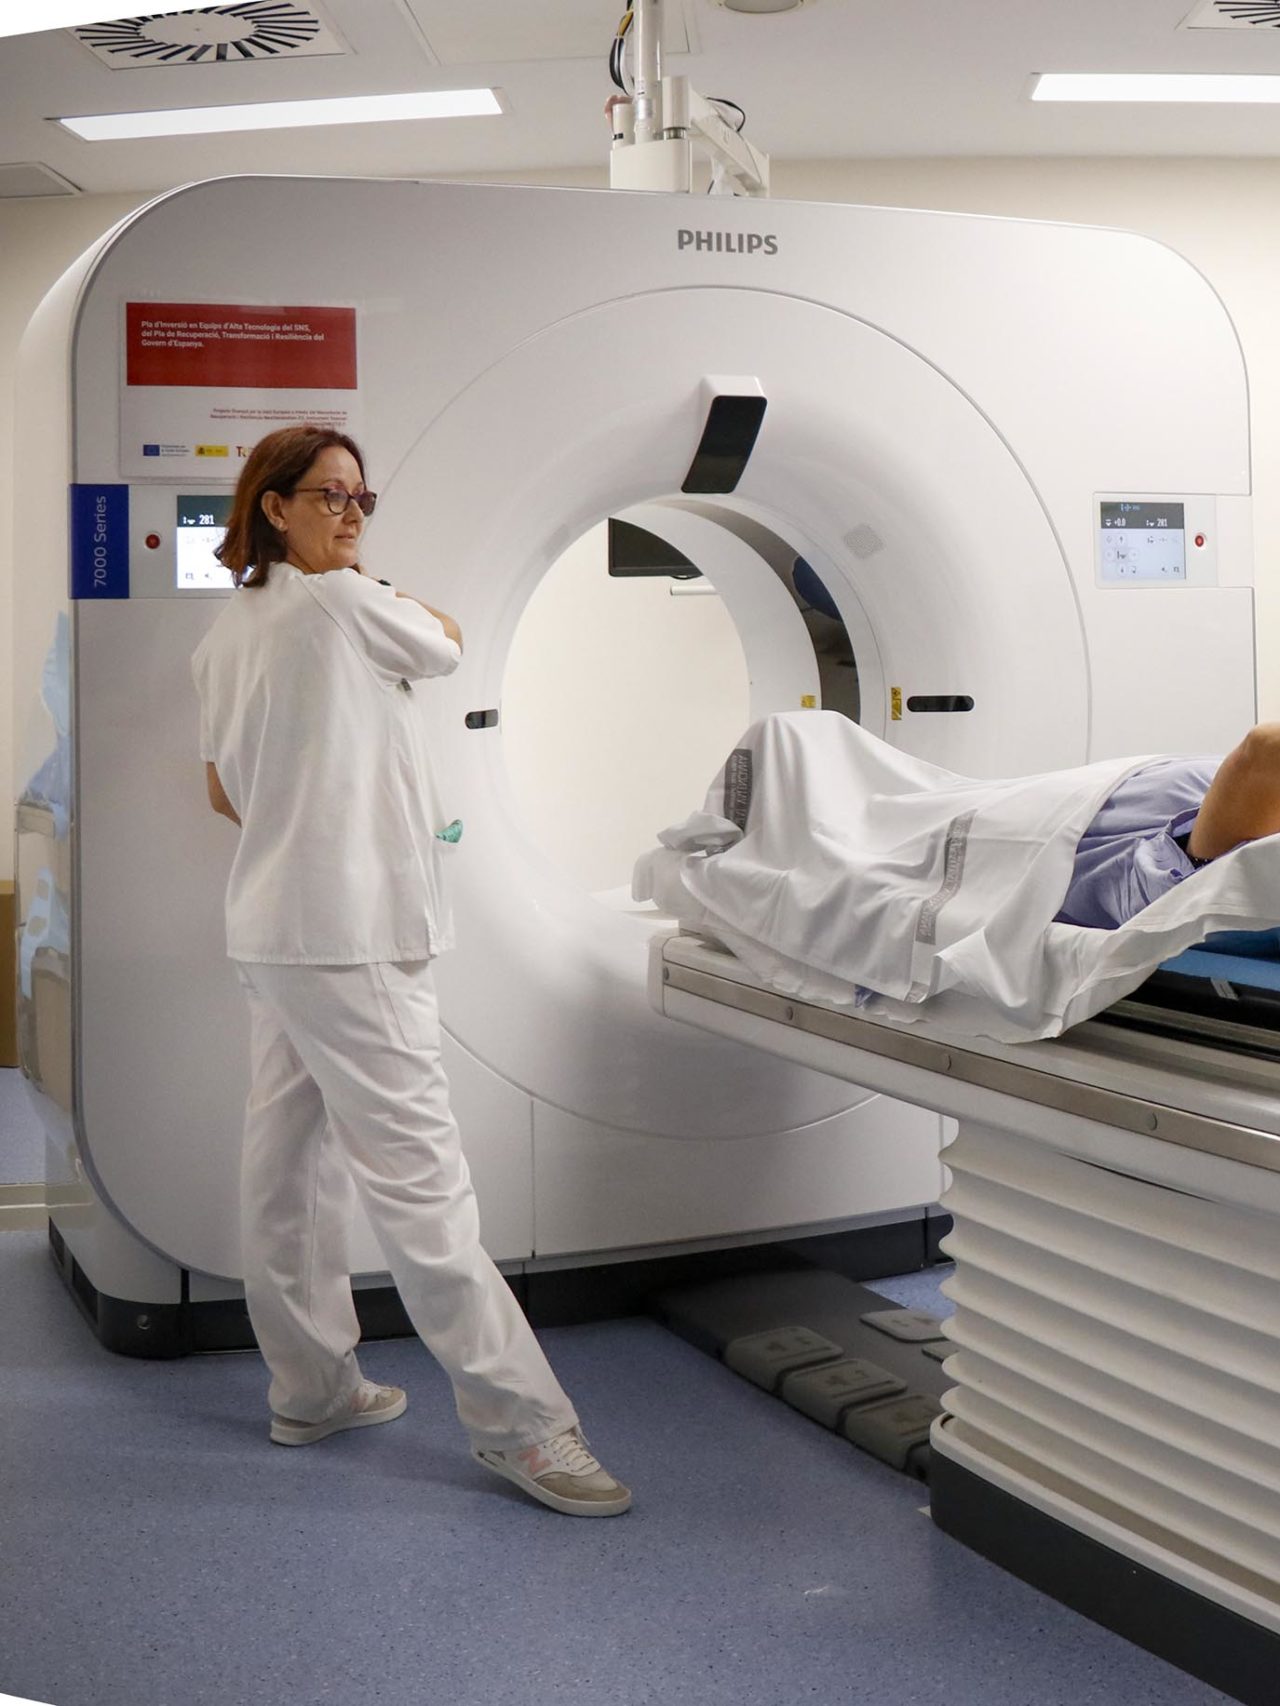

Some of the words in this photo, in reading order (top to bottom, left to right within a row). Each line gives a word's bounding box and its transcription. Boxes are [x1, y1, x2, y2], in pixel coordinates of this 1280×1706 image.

[677, 229, 778, 255] PHILIPS
[141, 320, 153, 328] Pla
[222, 331, 270, 340] Transformació
[313, 333, 324, 341] del
[141, 339, 167, 347] Govern
[94, 495, 107, 542] Series
[199, 514, 215, 525] 281
[94, 547, 107, 588] 7000
